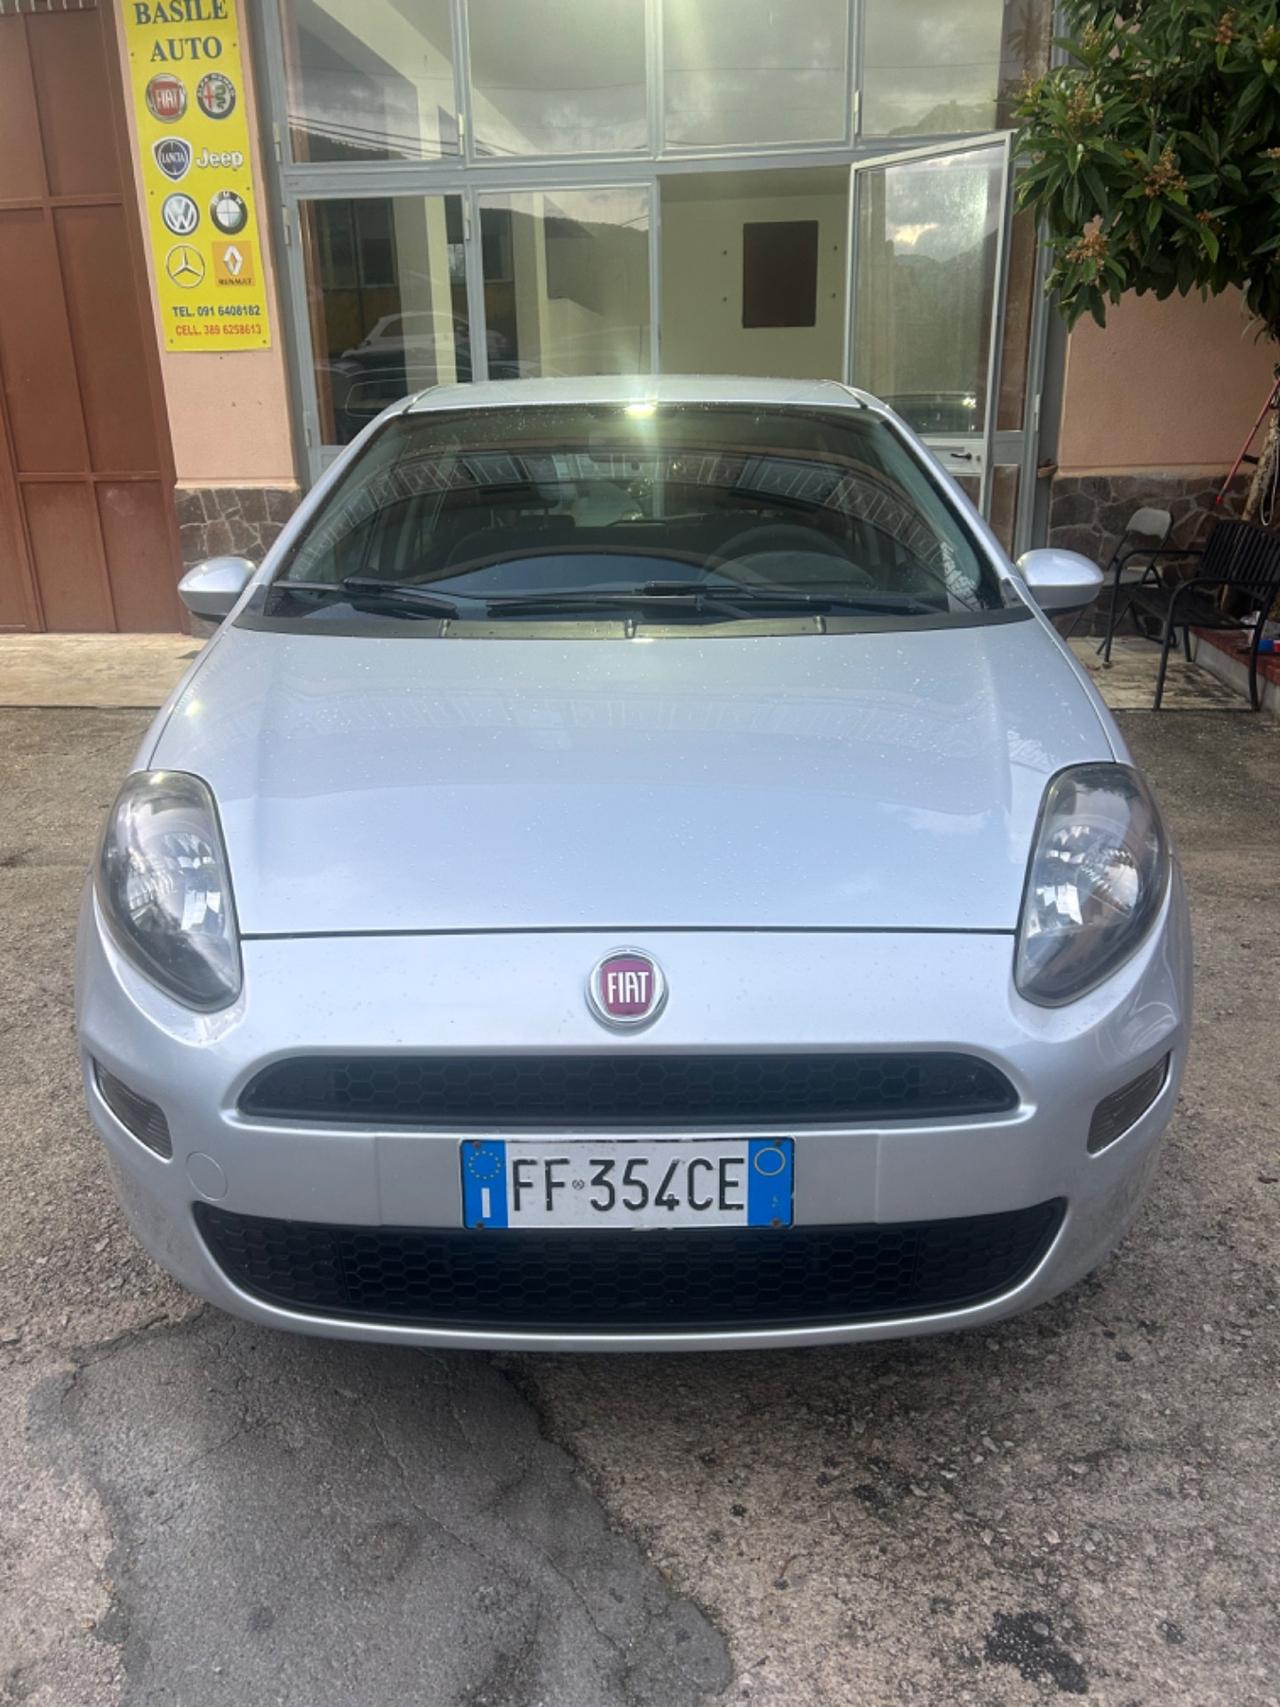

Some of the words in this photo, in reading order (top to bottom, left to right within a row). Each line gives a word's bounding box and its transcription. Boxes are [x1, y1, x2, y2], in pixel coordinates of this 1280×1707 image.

[134, 0, 228, 25] BASILE
[150, 36, 222, 62] AUTO
[155, 89, 178, 109] FIAT
[162, 151, 185, 163] LANCIA
[196, 149, 243, 169] Jeep
[172, 306, 195, 317] TEL.
[198, 306, 214, 316] 091
[218, 305, 261, 316] 6408182
[175, 326, 201, 337] CELL.
[204, 325, 220, 335] 389
[223, 324, 261, 335] 6258613
[607, 971, 649, 1004] FIAT
